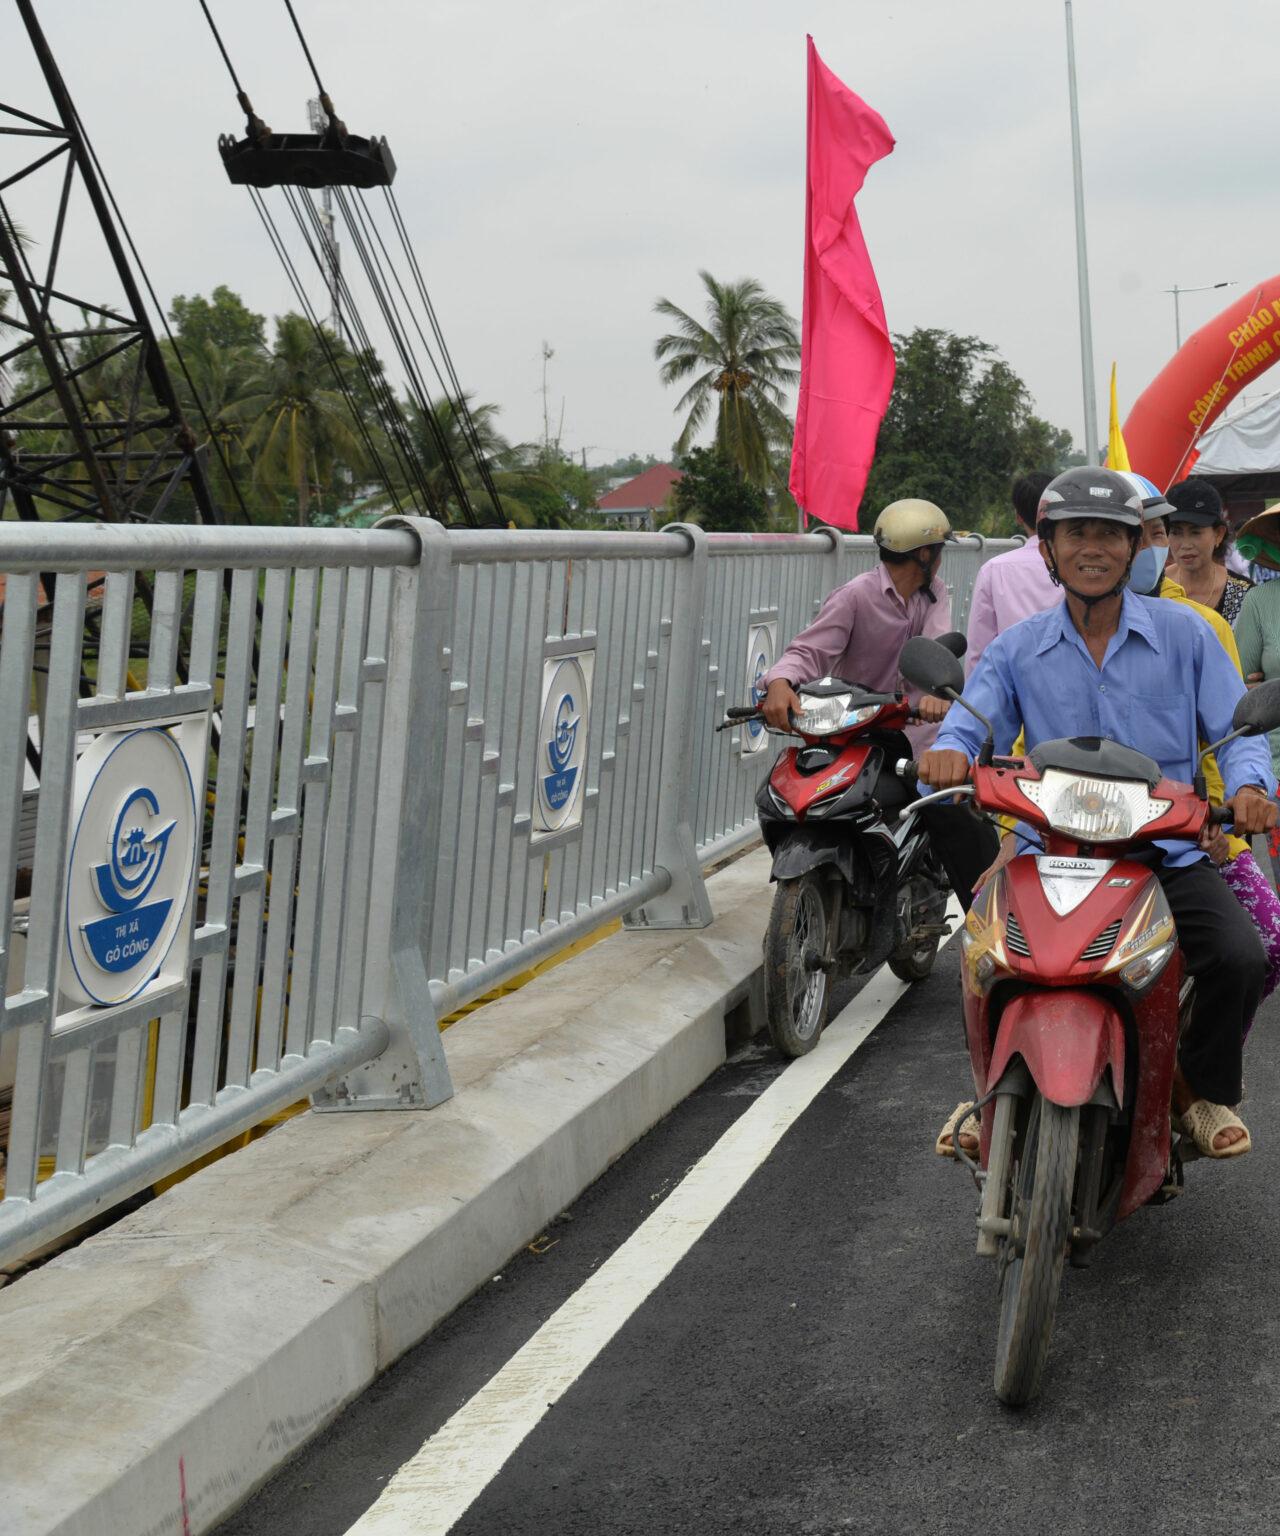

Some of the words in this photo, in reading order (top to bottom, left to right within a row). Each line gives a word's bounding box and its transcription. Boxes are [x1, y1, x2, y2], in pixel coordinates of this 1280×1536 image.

[1228, 308, 1274, 348] CHÀO
[1188, 380, 1229, 426] CÔNG
[1226, 340, 1274, 382] TRÌNH
[1049, 860, 1095, 870] HONDA
[115, 925, 127, 939] THỊ
[129, 918, 140, 933] XÃ
[105, 944, 120, 963] GÒ
[122, 938, 149, 958] CÔNG
